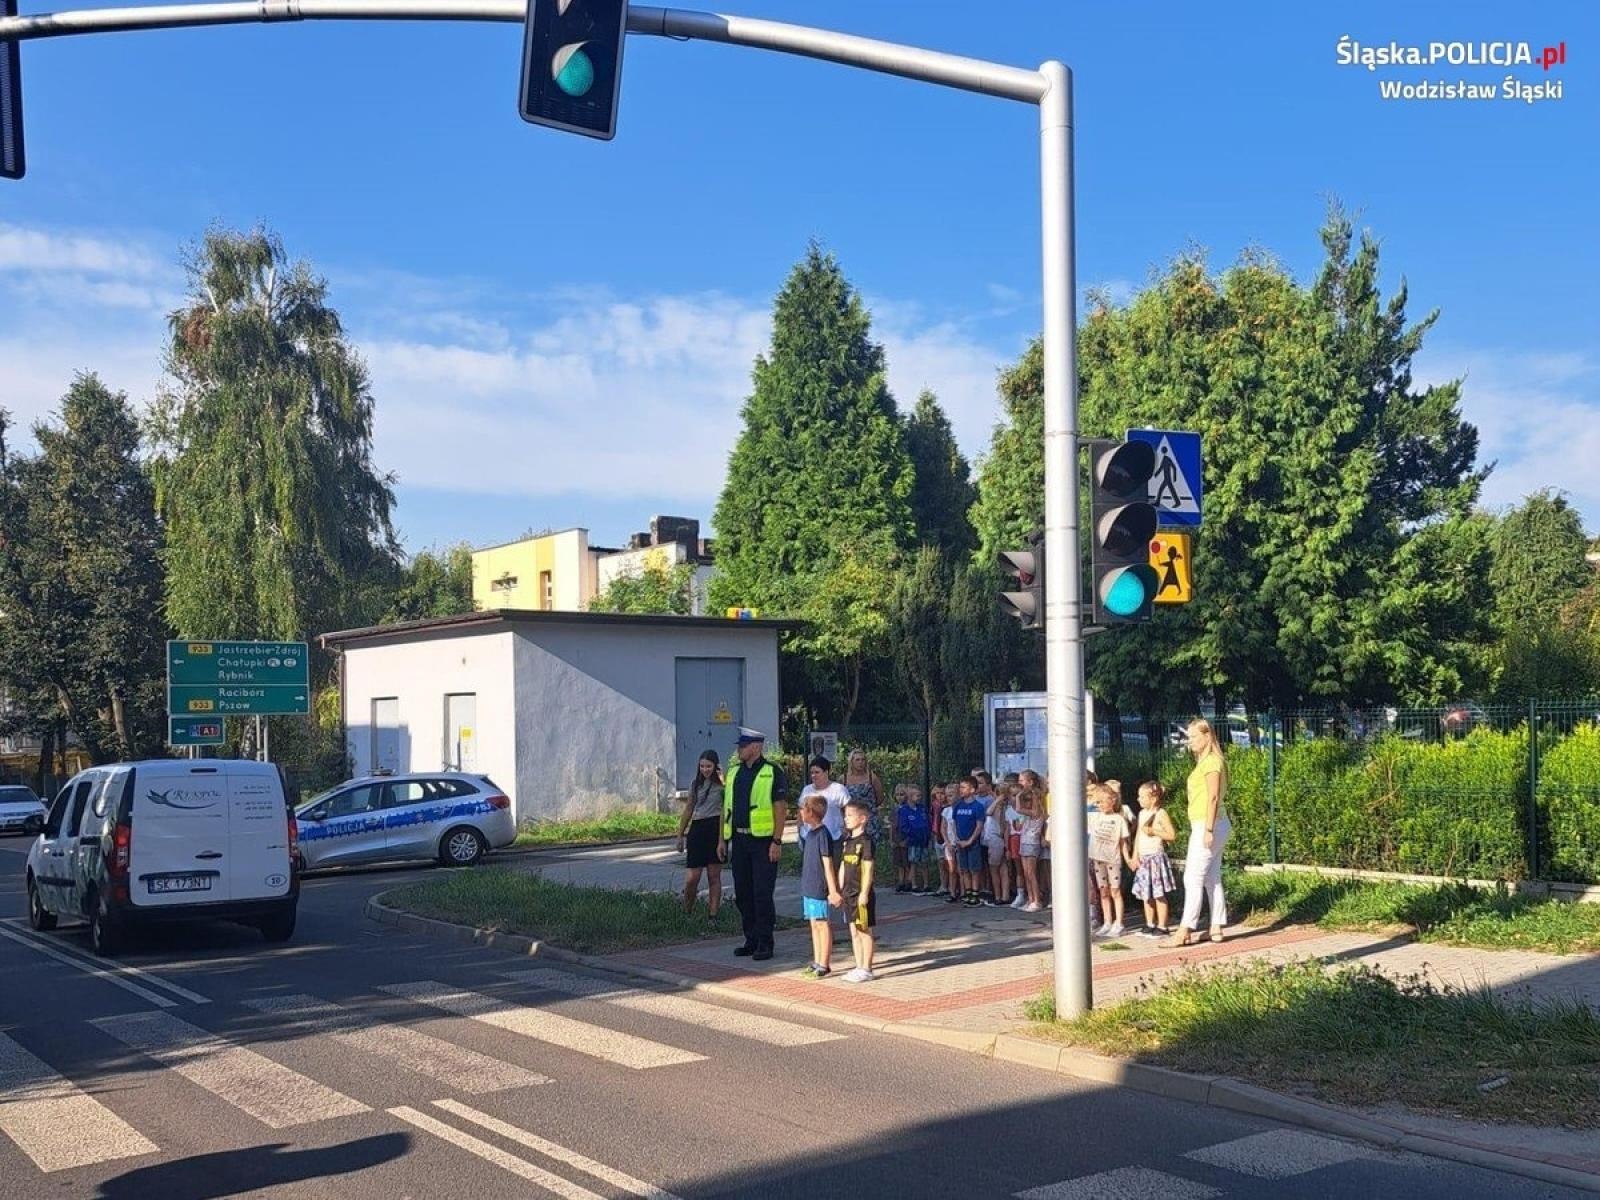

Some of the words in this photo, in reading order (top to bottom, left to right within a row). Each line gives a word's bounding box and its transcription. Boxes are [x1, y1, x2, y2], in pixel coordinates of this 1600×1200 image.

[217, 657, 266, 668] Chałupki
[218, 671, 255, 680] Rybnik
[219, 687, 265, 697] Racibórz
[326, 822, 366, 834] POLICJA
